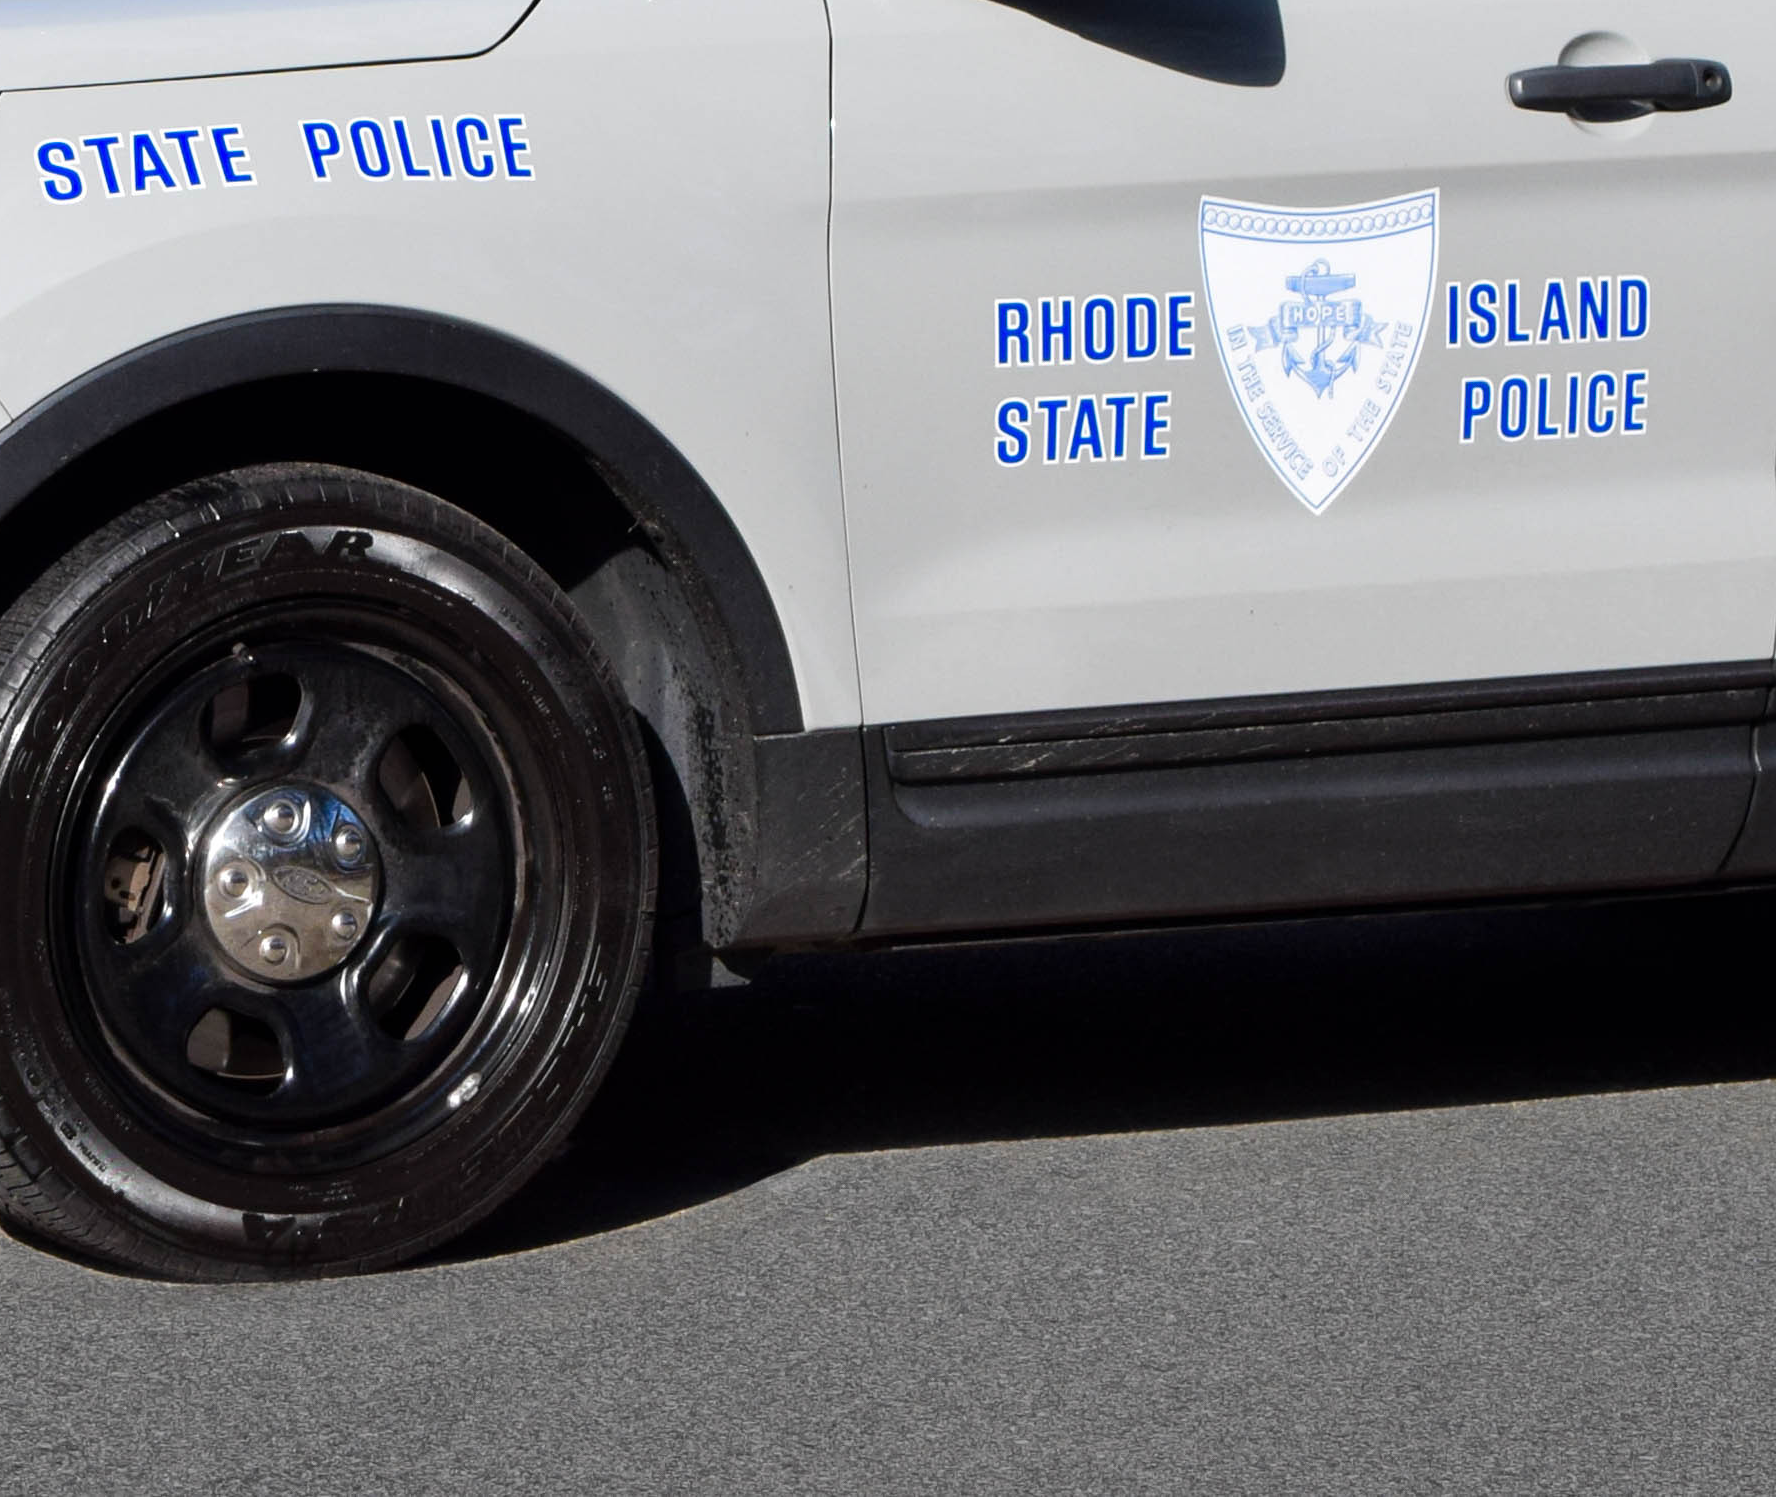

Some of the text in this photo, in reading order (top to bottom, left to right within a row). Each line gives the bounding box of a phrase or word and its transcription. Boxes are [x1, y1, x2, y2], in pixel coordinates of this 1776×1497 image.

[36, 116, 534, 202] STATE POLICE
[997, 278, 1649, 365] RHODE ISLAND
[1293, 305, 1347, 322] HOPE
[996, 373, 1648, 464] STATE POLICE
[1226, 320, 1413, 480] IN THE SERVICE OF THE STATE
